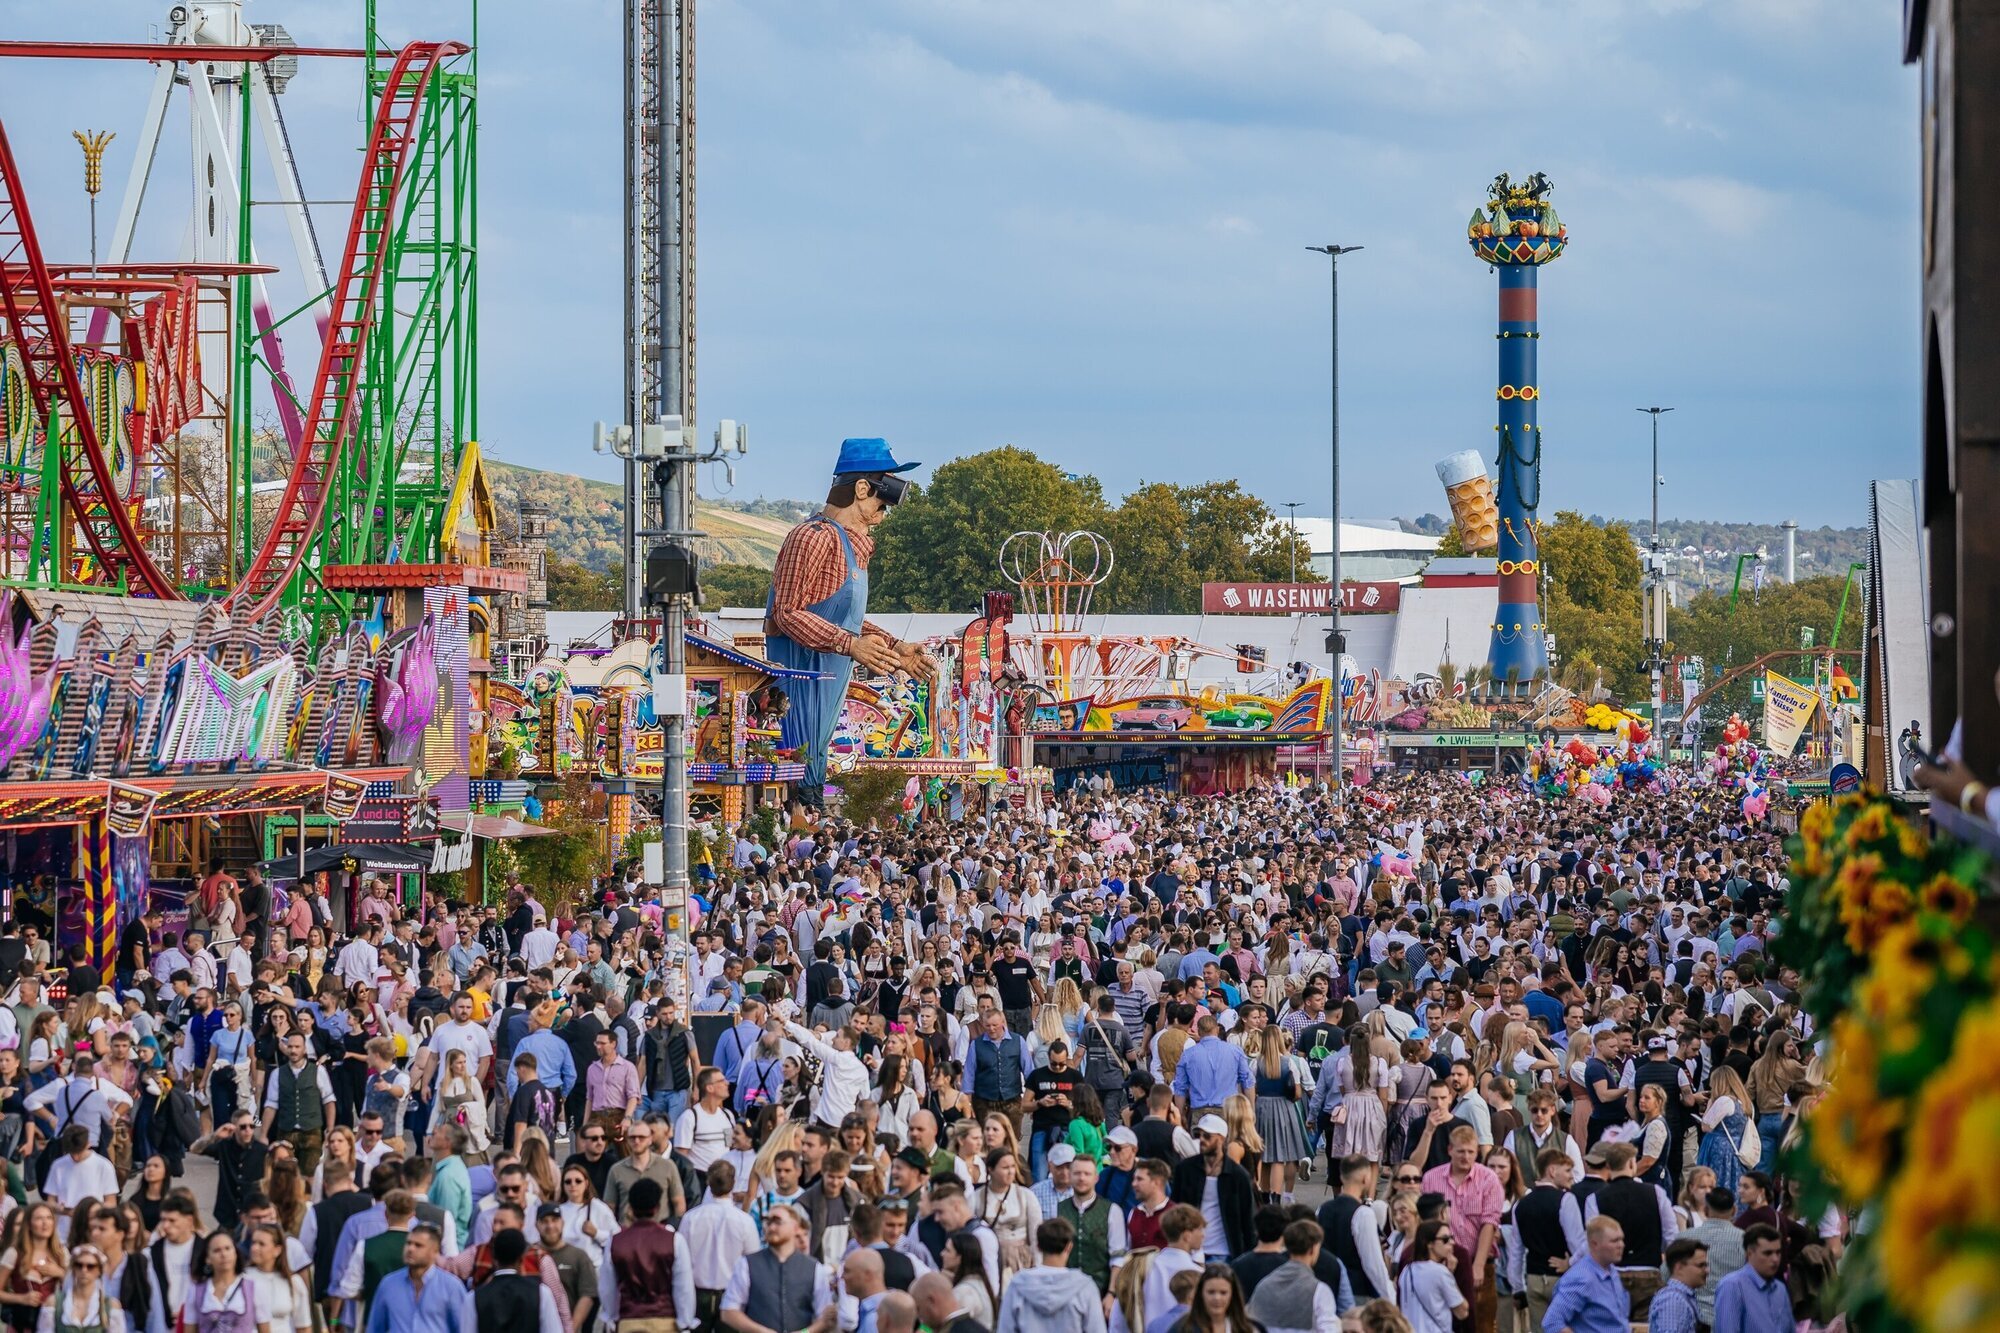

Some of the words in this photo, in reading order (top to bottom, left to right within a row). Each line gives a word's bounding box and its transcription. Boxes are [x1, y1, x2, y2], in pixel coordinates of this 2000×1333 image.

[1450, 736, 1471, 745] LWH
[363, 809, 383, 819] und
[385, 809, 400, 819] ich
[366, 860, 419, 870] Weltallrekord!
